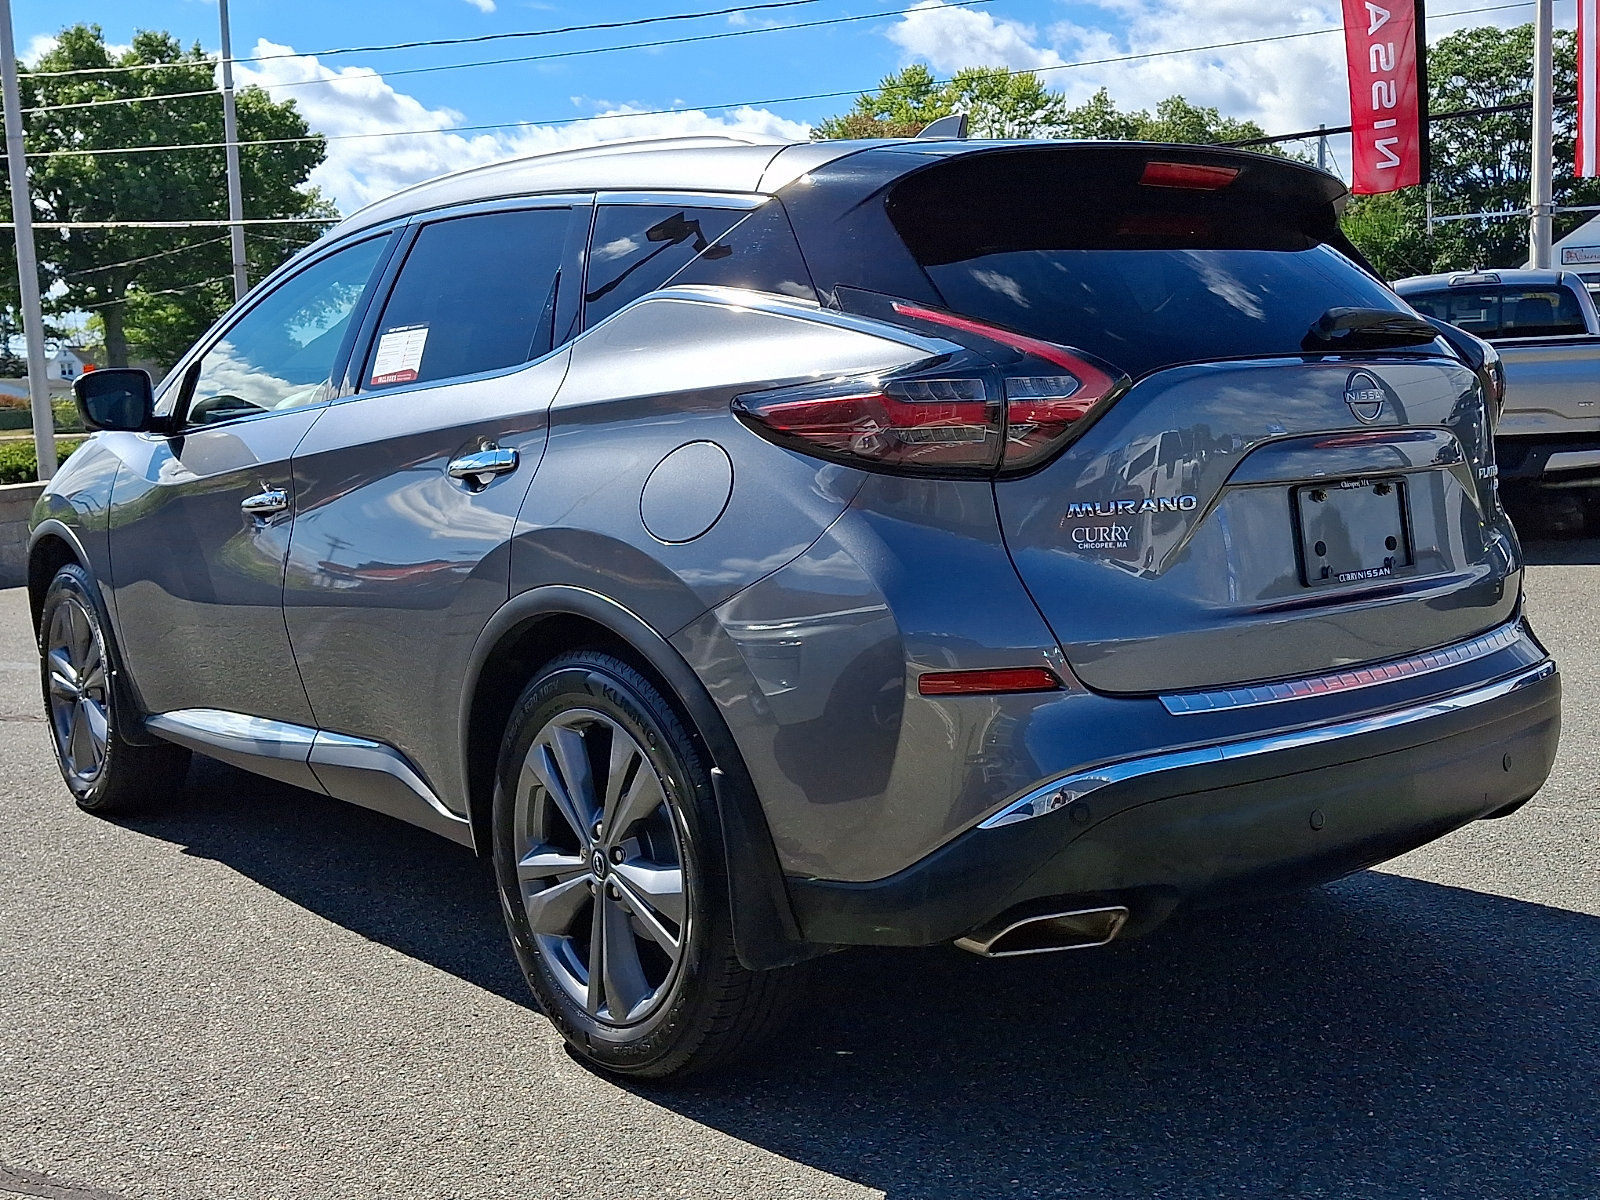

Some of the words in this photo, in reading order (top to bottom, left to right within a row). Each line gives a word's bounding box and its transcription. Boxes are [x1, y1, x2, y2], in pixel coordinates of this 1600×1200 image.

[1067, 495, 1197, 518] MURANO
[1072, 522, 1132, 543] CURRY
[1358, 567, 1391, 579] NISSAN
